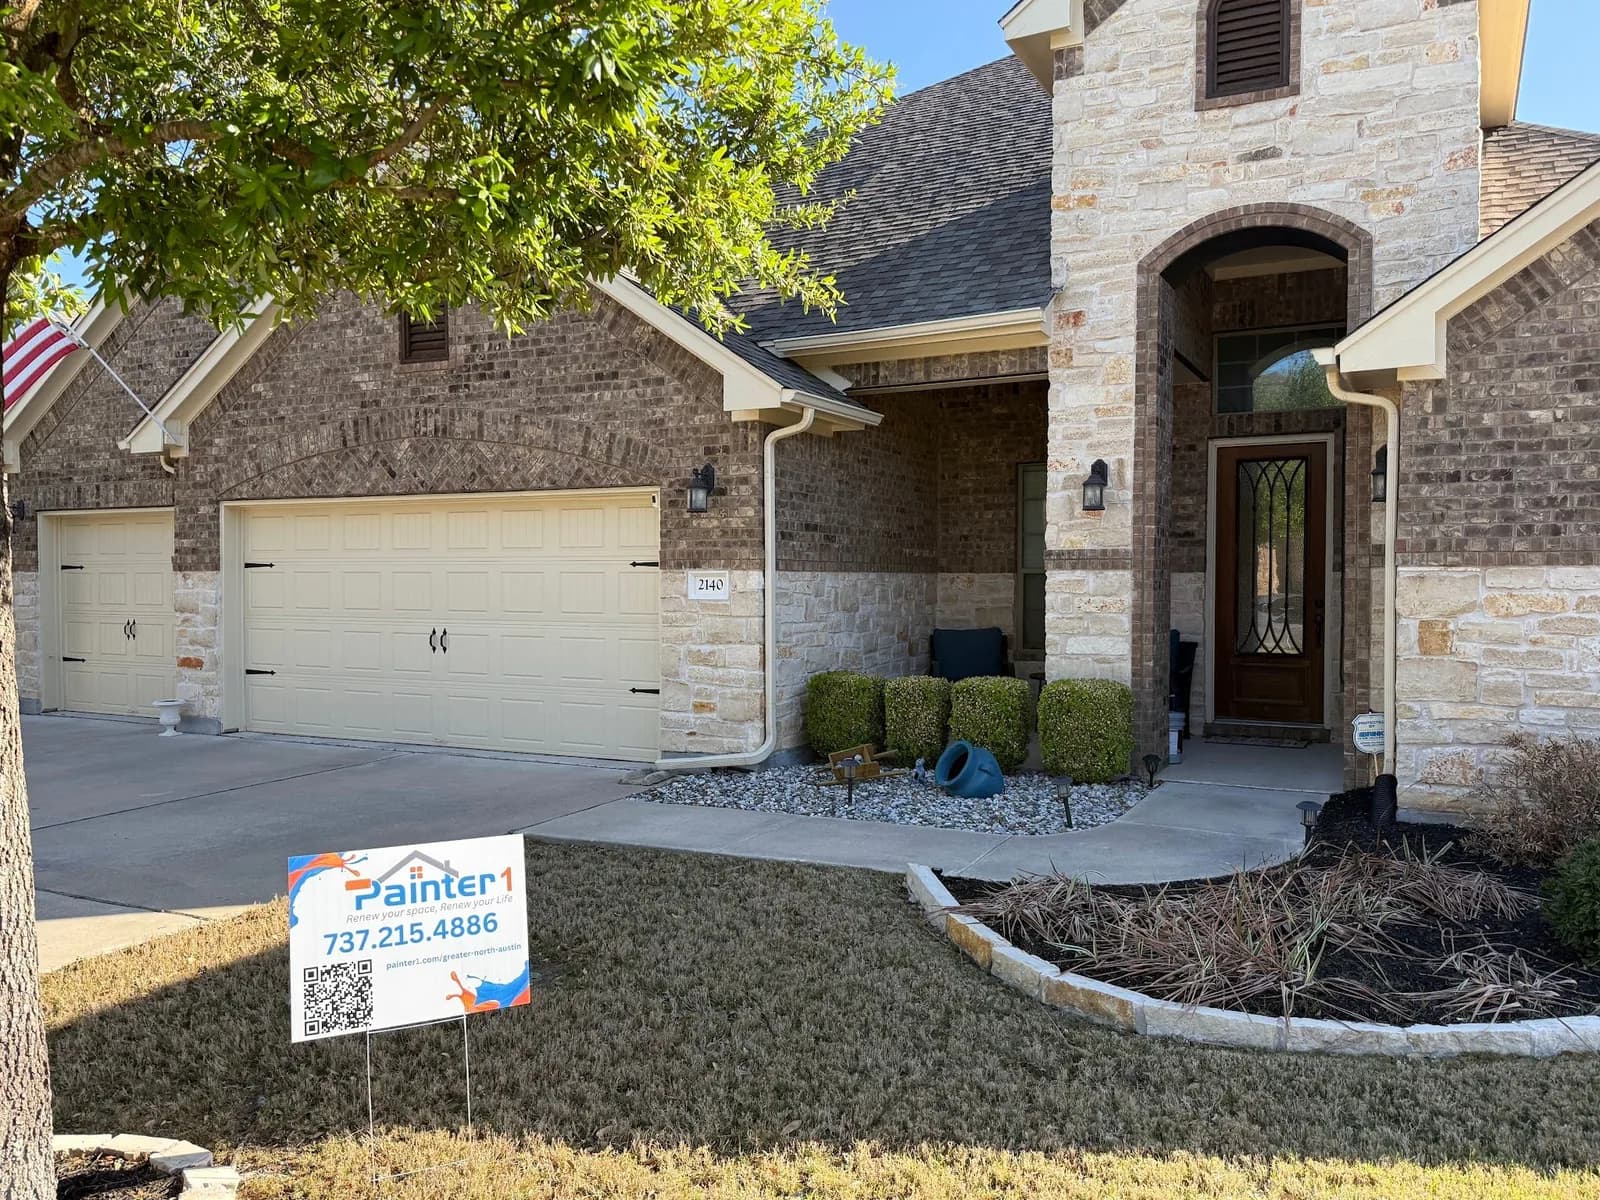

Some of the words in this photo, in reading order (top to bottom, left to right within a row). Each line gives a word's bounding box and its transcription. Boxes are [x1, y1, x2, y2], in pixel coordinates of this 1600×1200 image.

[698, 578, 724, 591] 2140
[346, 912, 380, 924] Renew
[381, 908, 404, 921] your
[406, 904, 438, 917] space,
[440, 900, 472, 912] Renew
[472, 897, 495, 909] your
[496, 894, 513, 904] Life
[323, 912, 498, 956] 737.215.4886
[386, 943, 522, 970] painter1.com/greater-north-austin
